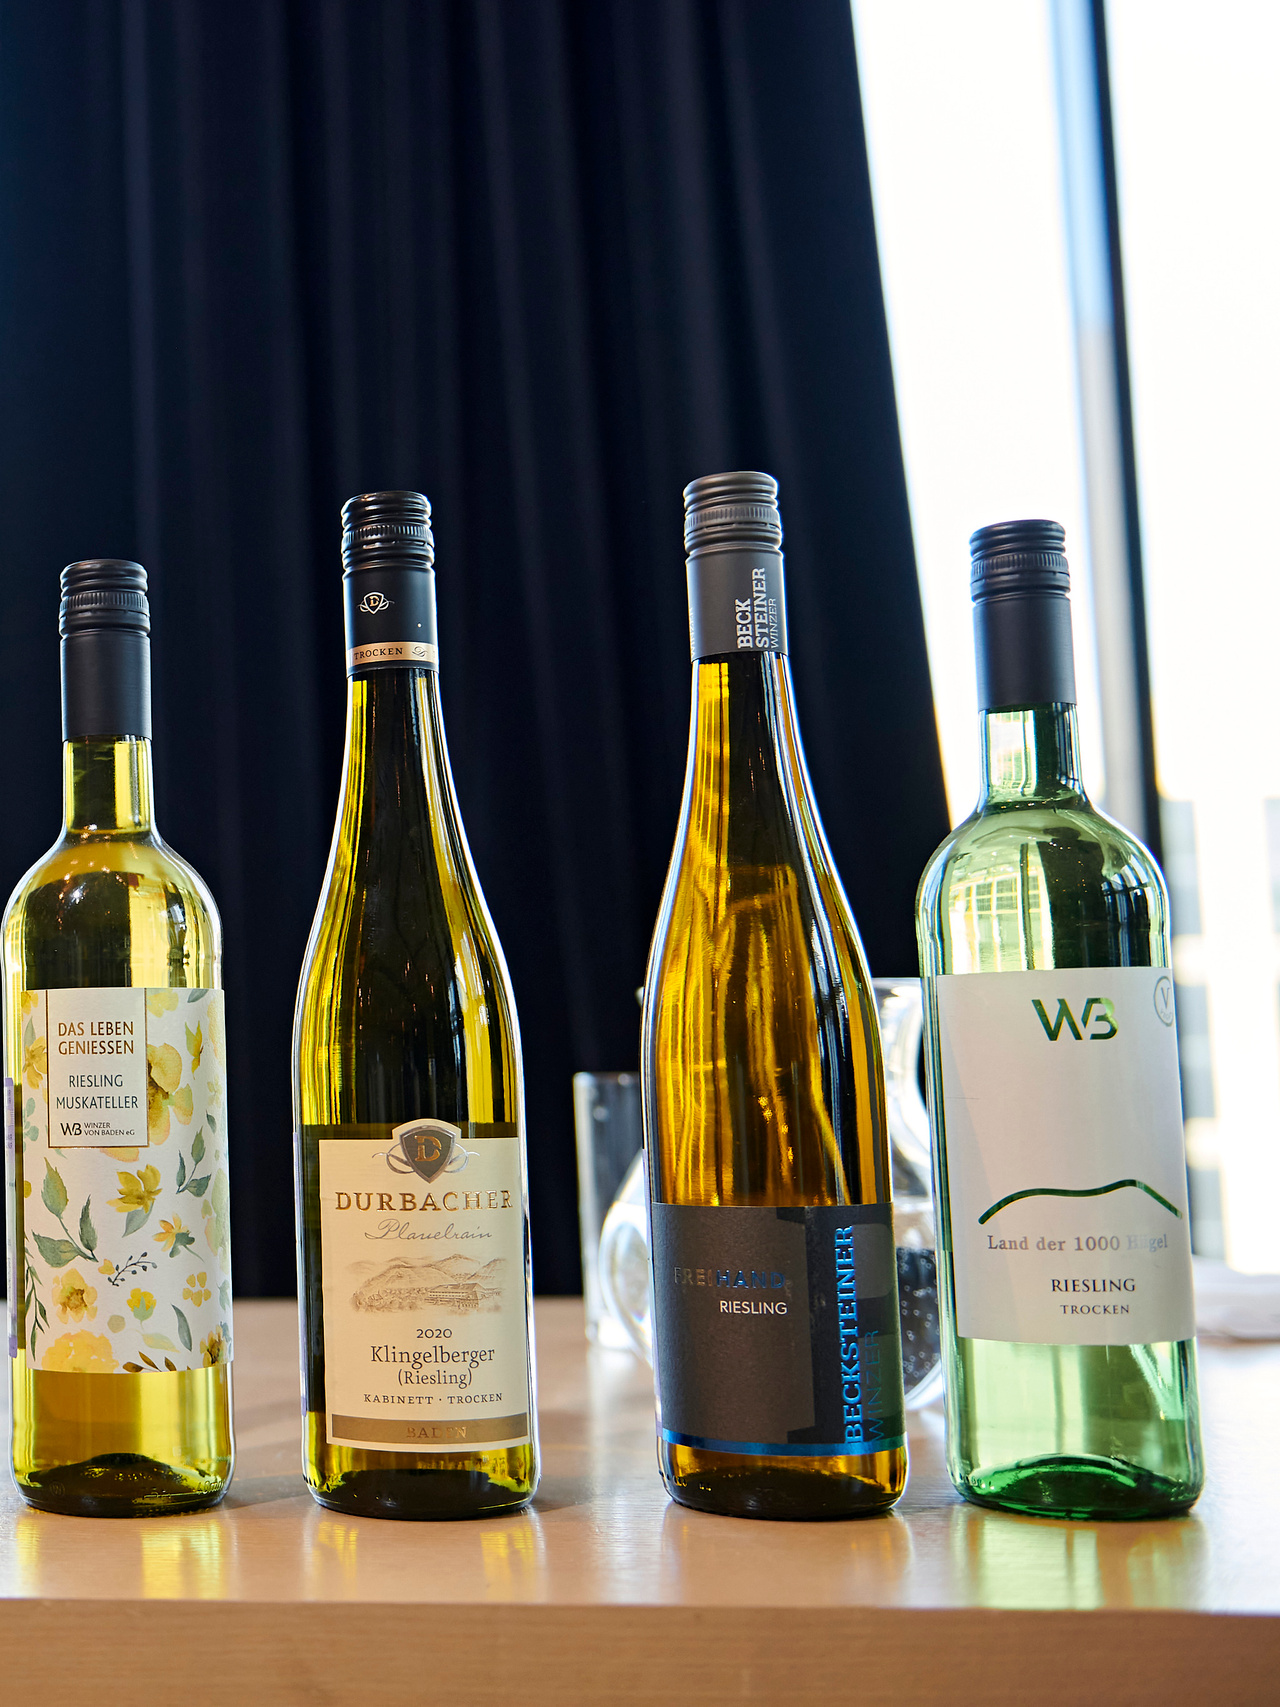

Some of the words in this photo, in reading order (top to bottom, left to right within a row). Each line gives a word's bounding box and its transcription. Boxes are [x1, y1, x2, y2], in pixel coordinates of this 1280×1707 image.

[752, 567, 770, 648] STEINER
[734, 598, 753, 649] BECK
[768, 598, 780, 649] WINZER
[354, 647, 404, 660] TROCKEN
[58, 1021, 85, 1037] DAS
[90, 1021, 134, 1036] LEBEN
[58, 1040, 135, 1055] GENIESSEN
[68, 1074, 124, 1088] RIESLING
[56, 1095, 139, 1109] MUSKATELLER
[84, 1121, 111, 1129] WINZER
[335, 1189, 514, 1212] DURBACHER
[987, 1235, 1029, 1250] Land
[1035, 1236, 1067, 1251] der
[1074, 1236, 1121, 1251] 1000
[674, 1266, 786, 1289] FREIHAND
[1051, 1278, 1137, 1293] RIESLING
[719, 1300, 788, 1315] RIESLING
[1060, 1303, 1130, 1316] TROCKEN
[416, 1328, 453, 1340] 2020
[834, 1225, 864, 1444] BECKSTEINER
[370, 1345, 496, 1369] Klingelberger
[397, 1368, 473, 1388] (Riesling)
[864, 1330, 885, 1442] WINZER
[363, 1393, 435, 1406] KABINETT
[447, 1392, 504, 1405] TROCKEN
[406, 1426, 468, 1439] BADEN
